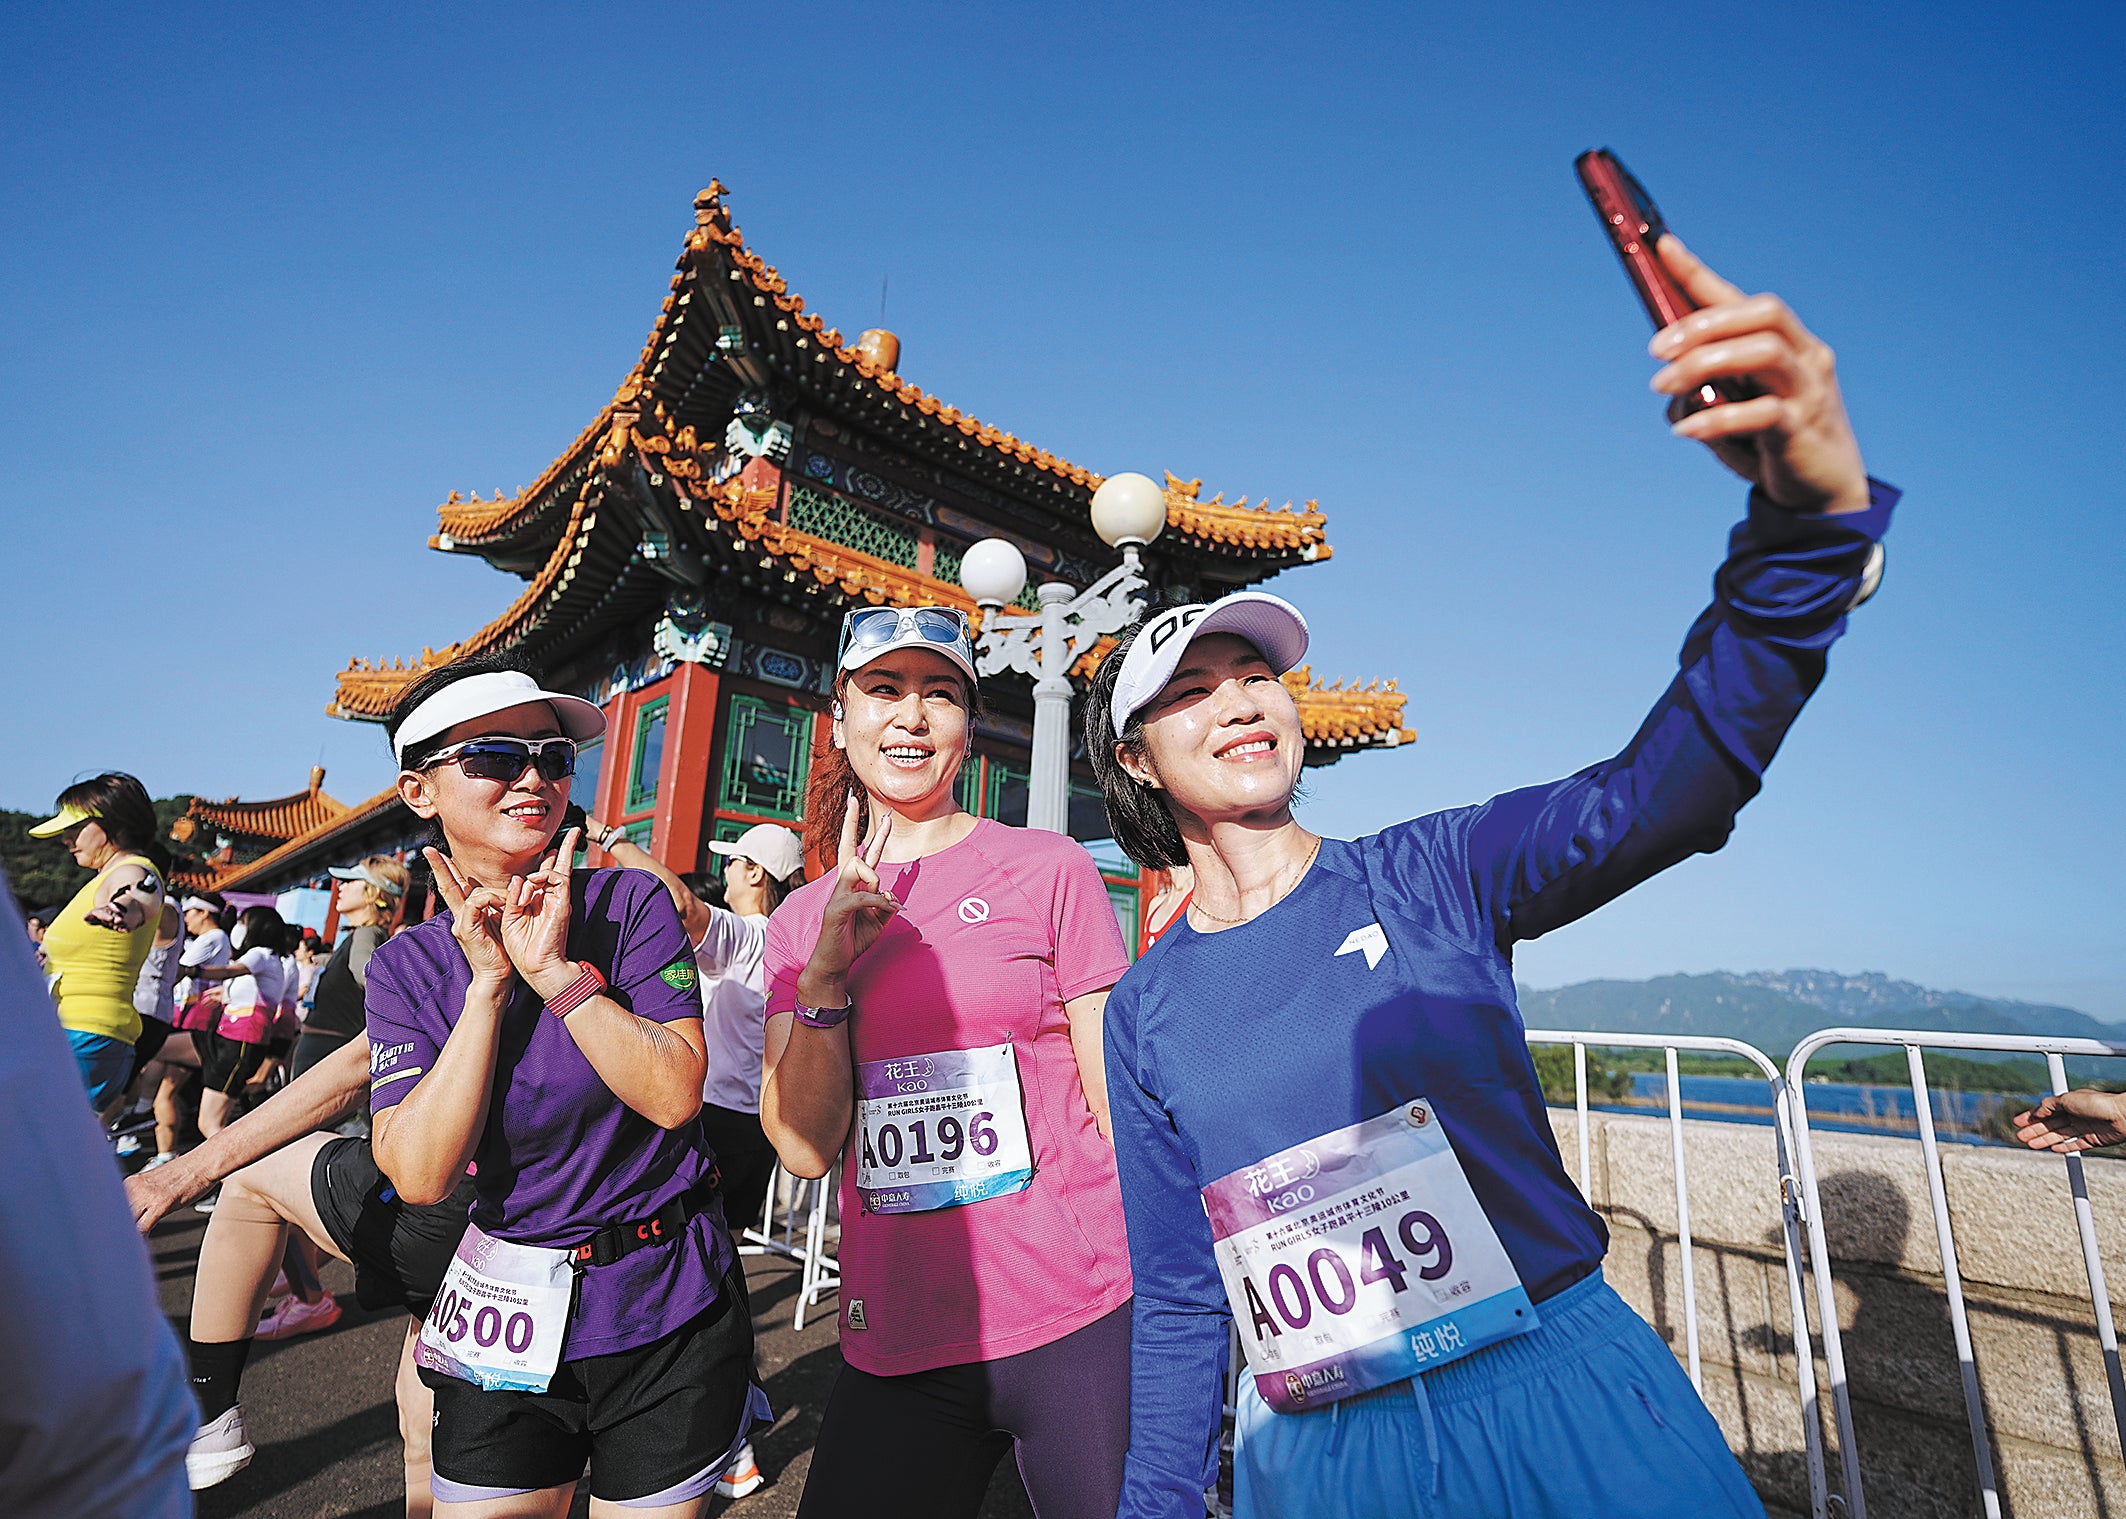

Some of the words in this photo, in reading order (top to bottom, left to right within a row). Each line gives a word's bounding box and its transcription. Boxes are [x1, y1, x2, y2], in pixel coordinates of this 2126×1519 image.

[884, 1060, 921, 1081] 花王
[862, 1111, 999, 1169] A0196
[953, 1183, 989, 1201] 纯悦
[1244, 1156, 1300, 1198] 花王
[1243, 1210, 1454, 1341] A0049
[427, 1281, 534, 1354] A0500
[1411, 1321, 1468, 1363] 纯悦
